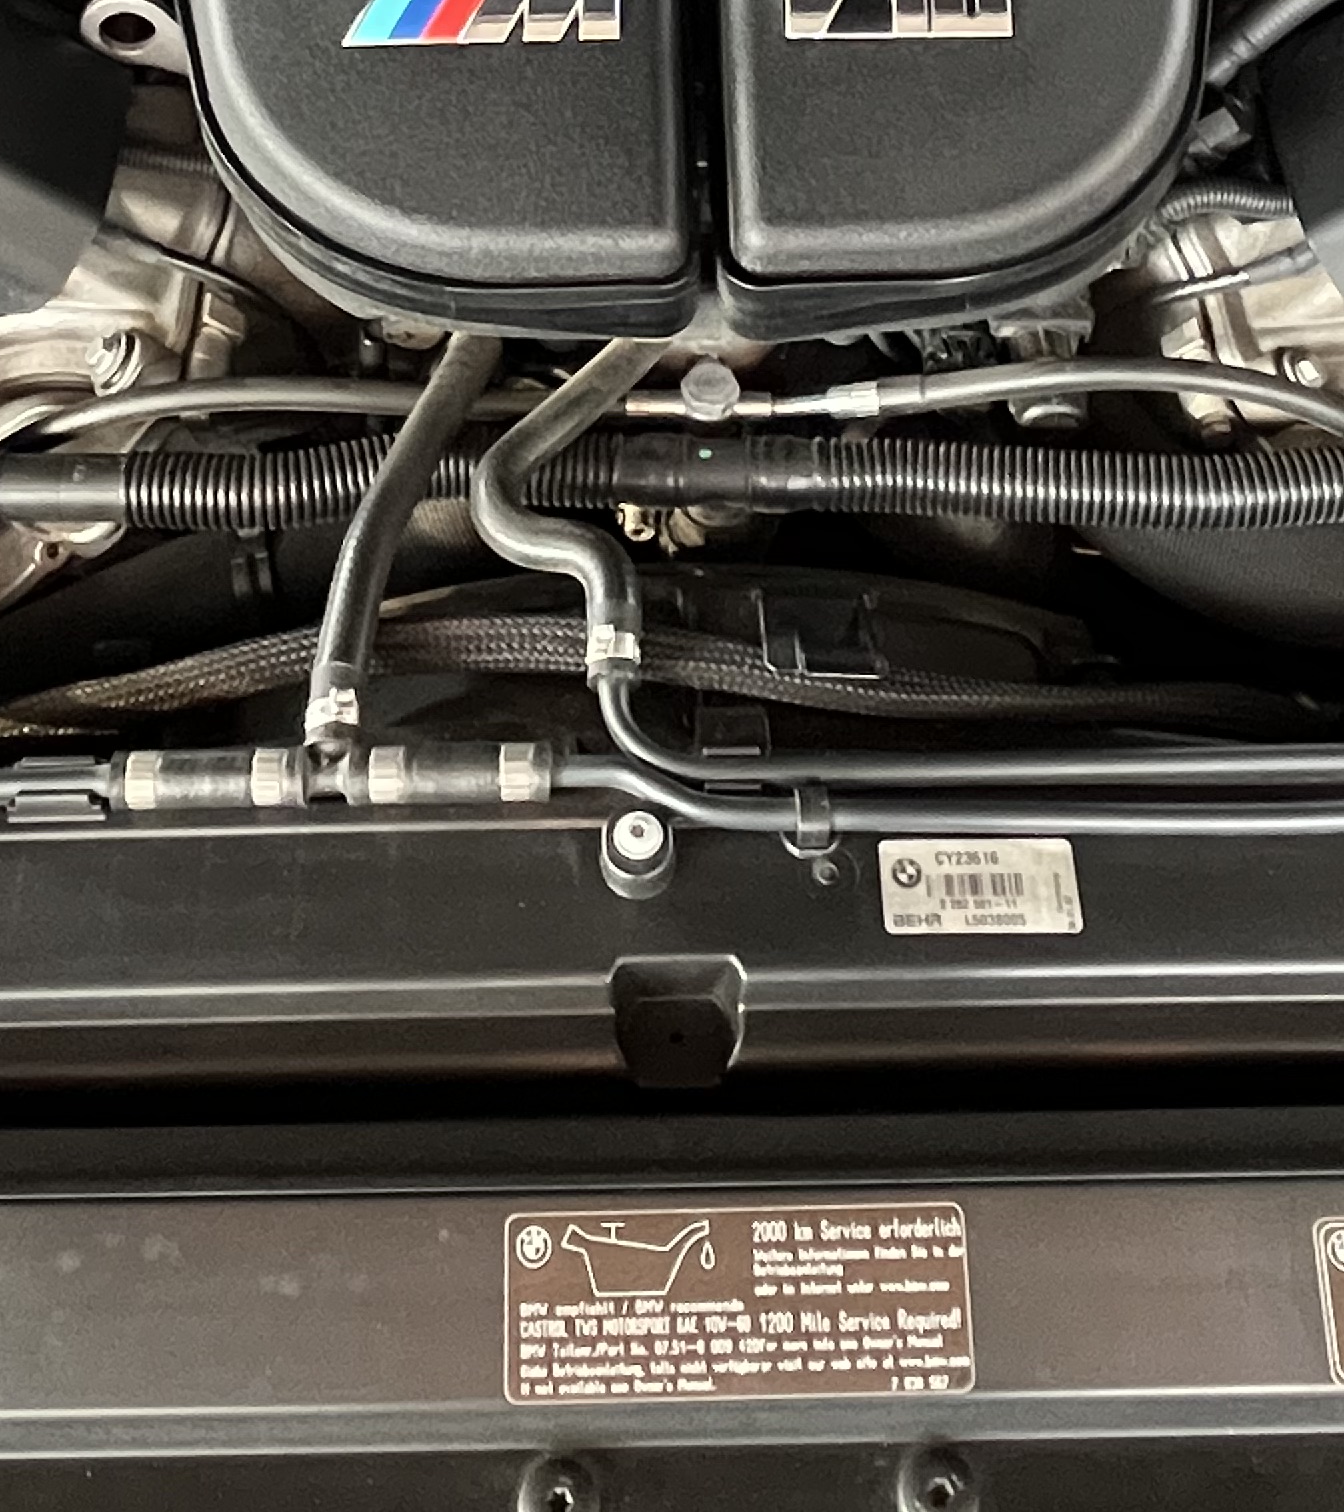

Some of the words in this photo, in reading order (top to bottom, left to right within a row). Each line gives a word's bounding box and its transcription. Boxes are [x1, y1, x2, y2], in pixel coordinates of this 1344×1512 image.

[893, 913, 942, 928] BEHR
[752, 1220, 787, 1243] 2000
[820, 1218, 872, 1242] Service
[759, 1310, 794, 1334] 1200
[800, 1310, 831, 1333] Mile
[838, 1308, 891, 1332] Service
[897, 1306, 962, 1334] Required!
